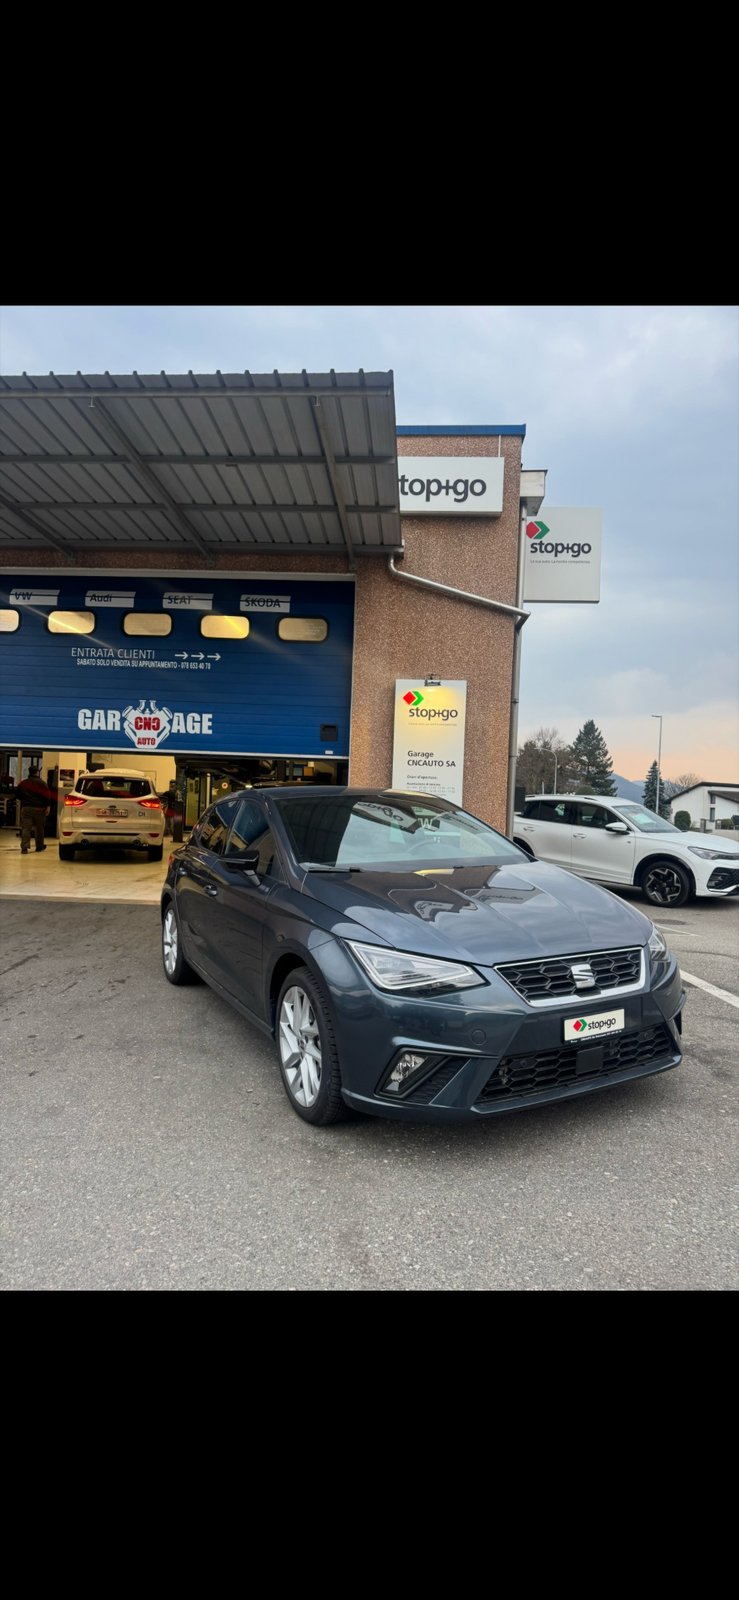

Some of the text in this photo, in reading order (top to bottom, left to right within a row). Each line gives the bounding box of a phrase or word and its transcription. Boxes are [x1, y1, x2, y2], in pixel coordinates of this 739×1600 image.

[398, 474, 487, 503] top+go
[530, 540, 592, 558] stop+go
[14, 591, 33, 600] VW
[89, 593, 113, 603] Audi
[167, 595, 193, 605] SEAT
[71, 647, 155, 659] ENTRATA CLIENTI
[76, 658, 96, 666] SABATO
[111, 659, 131, 667] VENDITA
[139, 660, 177, 669] APPUNTAMENTO
[409, 707, 458, 720] stop+go
[137, 737, 156, 746] AUTO
[407, 750, 434, 759] Garage
[407, 759, 456, 768] CNCAUTO SA
[588, 1018, 616, 1030] stop+go
